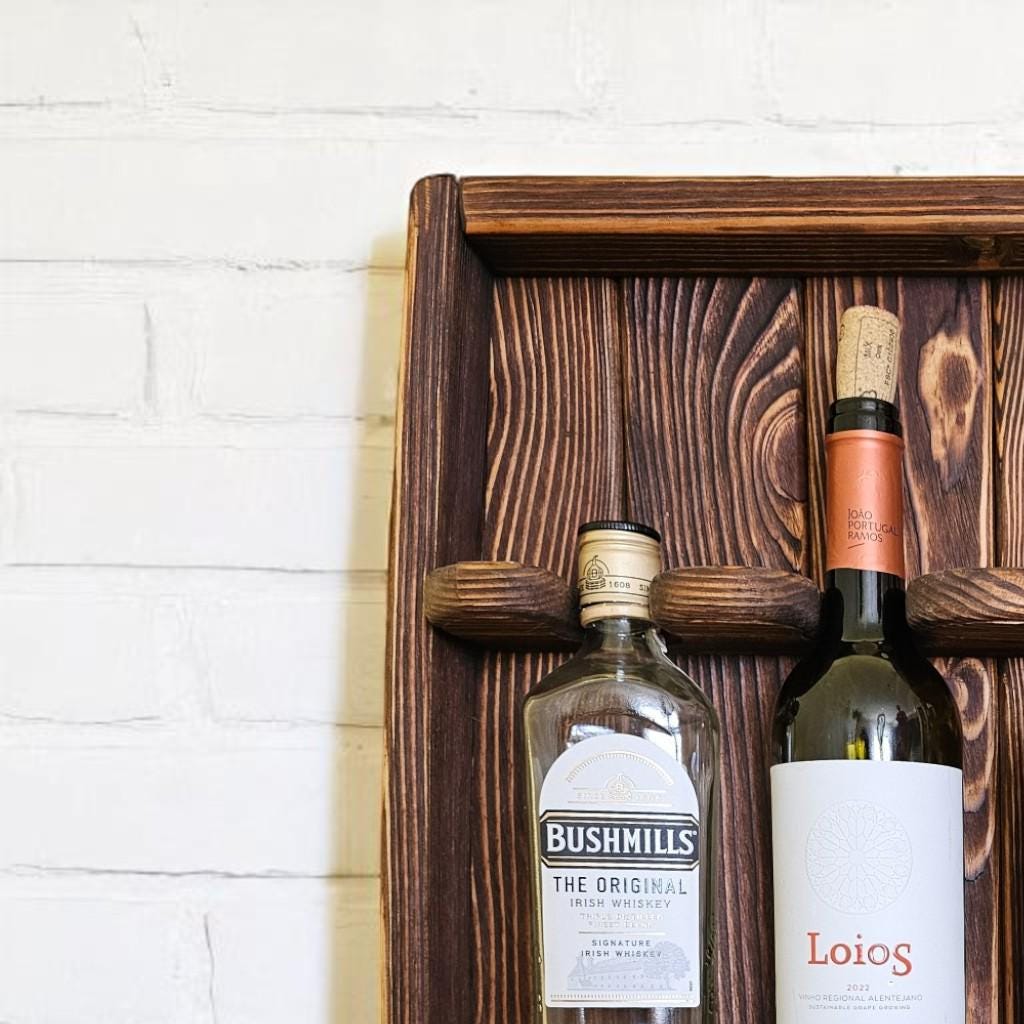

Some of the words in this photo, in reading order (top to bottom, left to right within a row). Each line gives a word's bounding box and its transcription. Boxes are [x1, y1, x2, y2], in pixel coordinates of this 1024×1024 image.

[847, 520, 899, 536] PORTUGAL
[847, 531, 883, 542] RAMOS
[545, 823, 696, 856] BUSHMILLS
[553, 876, 588, 893] THE
[596, 877, 688, 895] ORIGINAL
[570, 898, 605, 908] IRISH
[611, 899, 671, 909] WHISKEY
[591, 939, 651, 947] SIGNATURE
[581, 950, 610, 958] IRISH
[615, 950, 662, 958] WHISKEY
[807, 932, 913, 977] Loios
[846, 983, 870, 992] 2022
[823, 993, 866, 1002] REGIONAL
[868, 993, 923, 1002] ALENTEJANO
